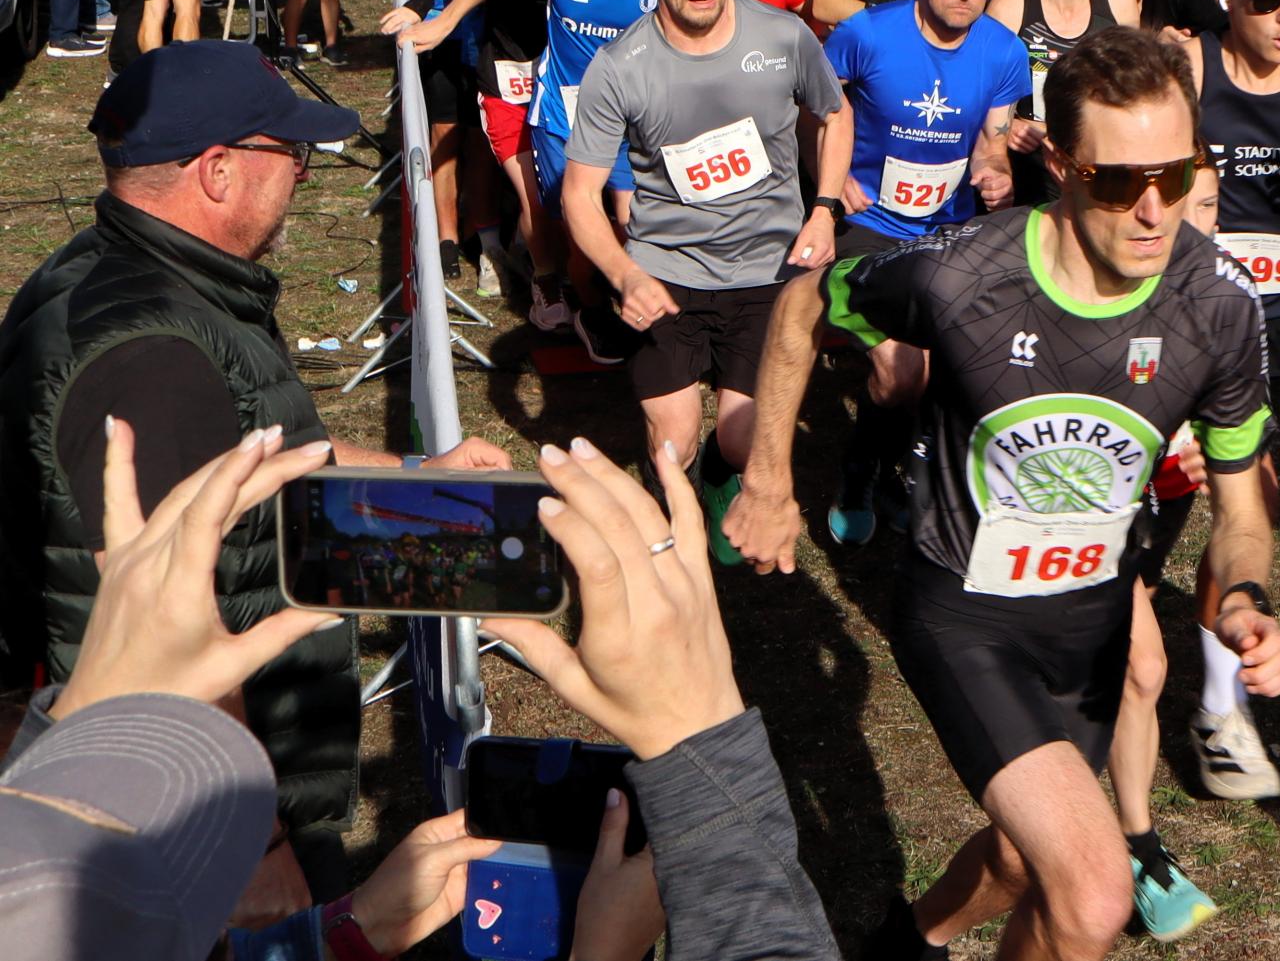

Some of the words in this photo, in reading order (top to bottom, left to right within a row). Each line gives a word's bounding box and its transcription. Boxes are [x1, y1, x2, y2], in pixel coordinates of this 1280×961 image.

[580, 22, 624, 39] Hum
[746, 60, 765, 72] ikk
[765, 55, 787, 67] gesund
[775, 63, 787, 72] plus
[890, 124, 962, 139] BLANKENESE
[685, 148, 751, 191] 556
[894, 180, 948, 207] 521
[996, 418, 1143, 467] FAHRRAD
[1007, 543, 1107, 582] 168
